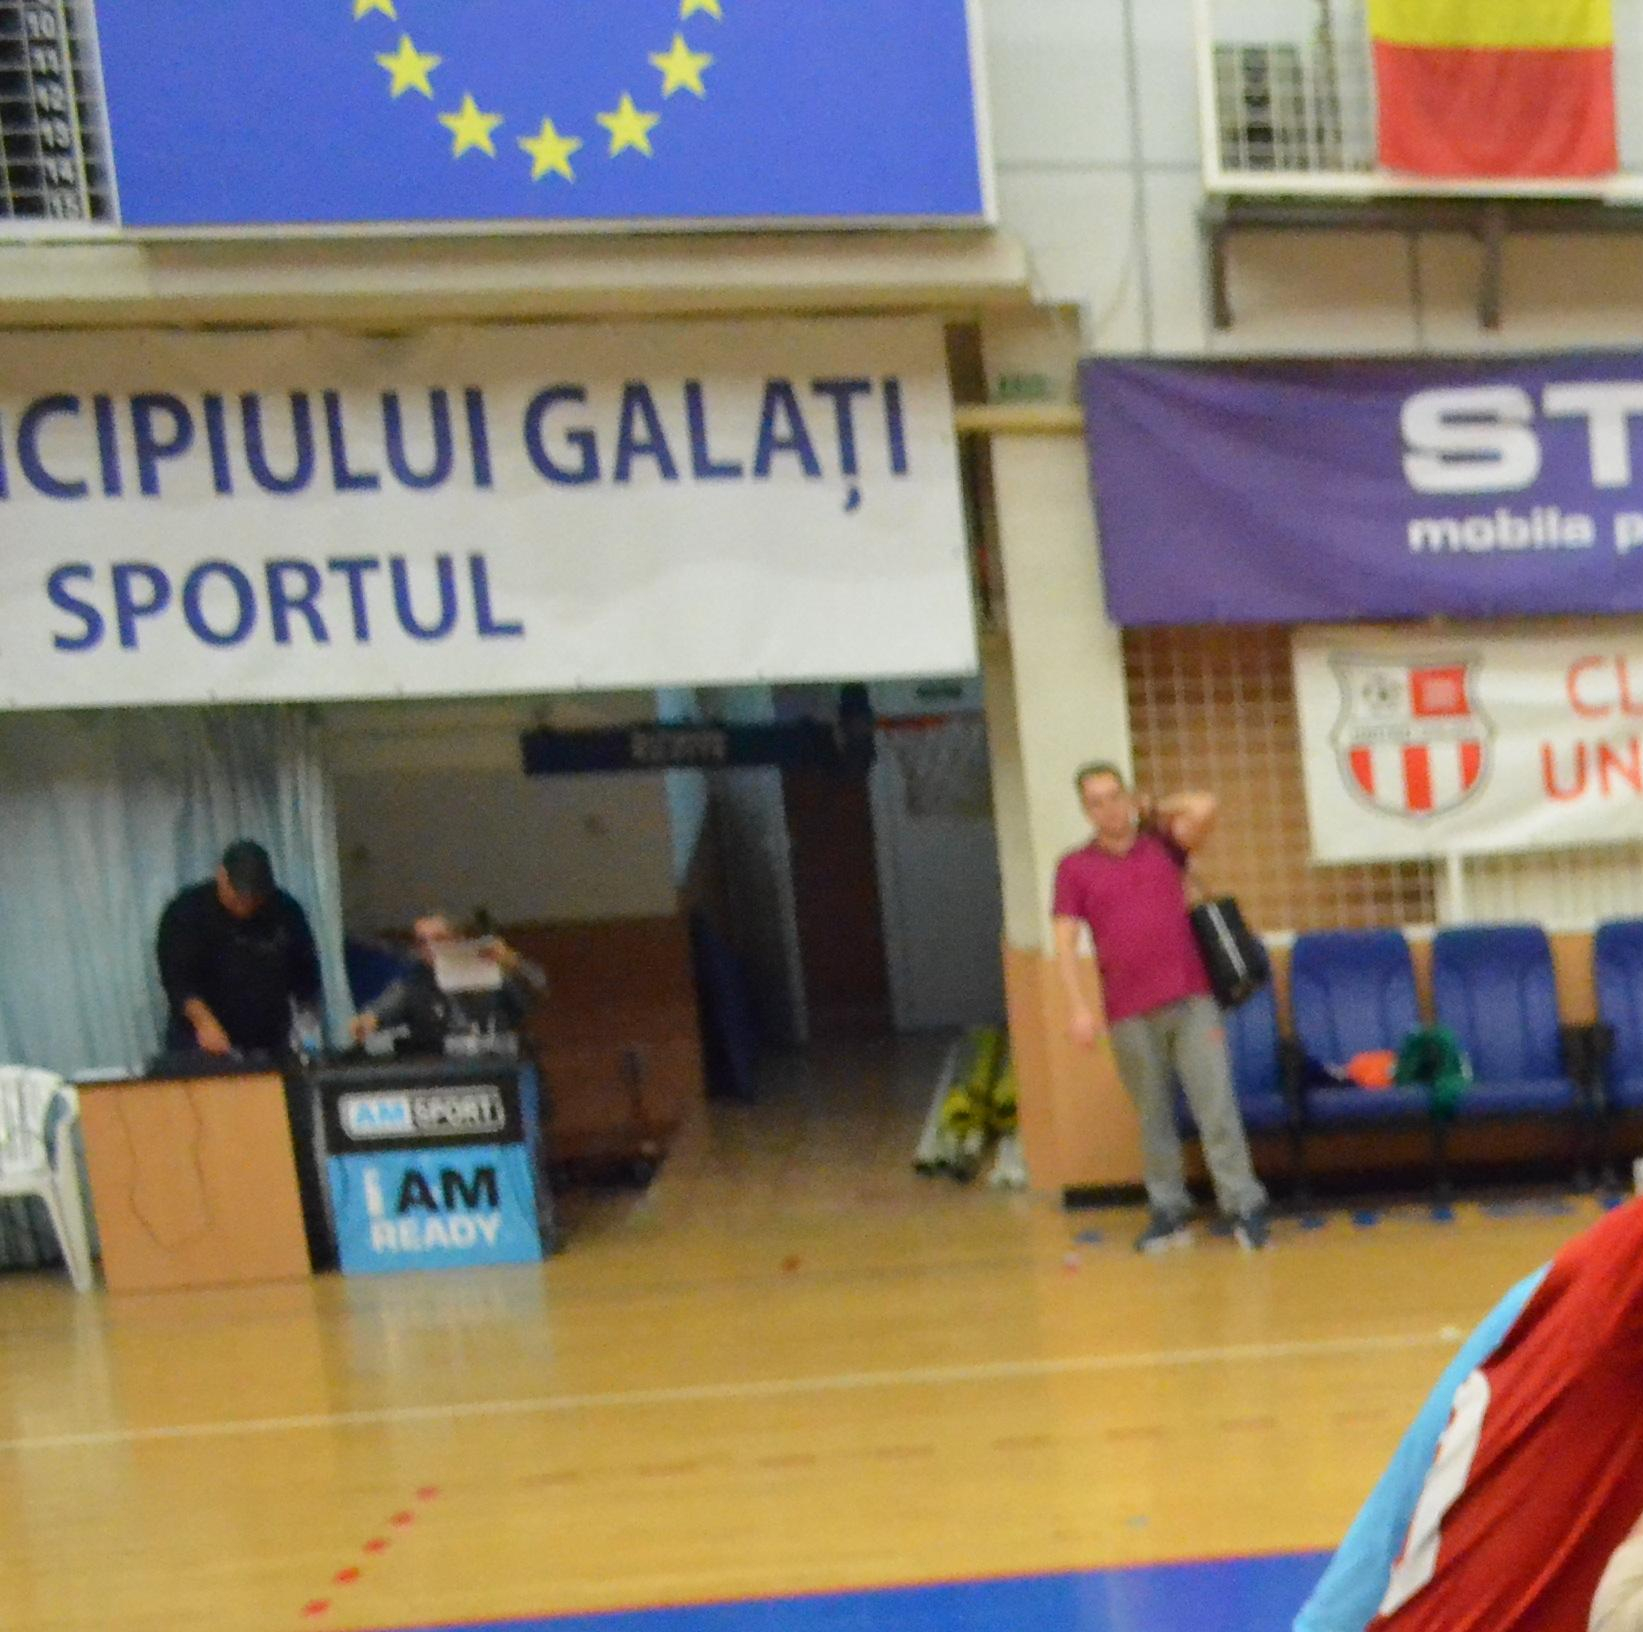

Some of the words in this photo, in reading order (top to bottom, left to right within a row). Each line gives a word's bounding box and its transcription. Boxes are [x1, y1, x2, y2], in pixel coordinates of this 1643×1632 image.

[0, 386, 492, 499] CIPIULUI
[47, 553, 524, 652] SPORTUL
[397, 1166, 500, 1214] AM
[369, 1213, 500, 1251] READY
